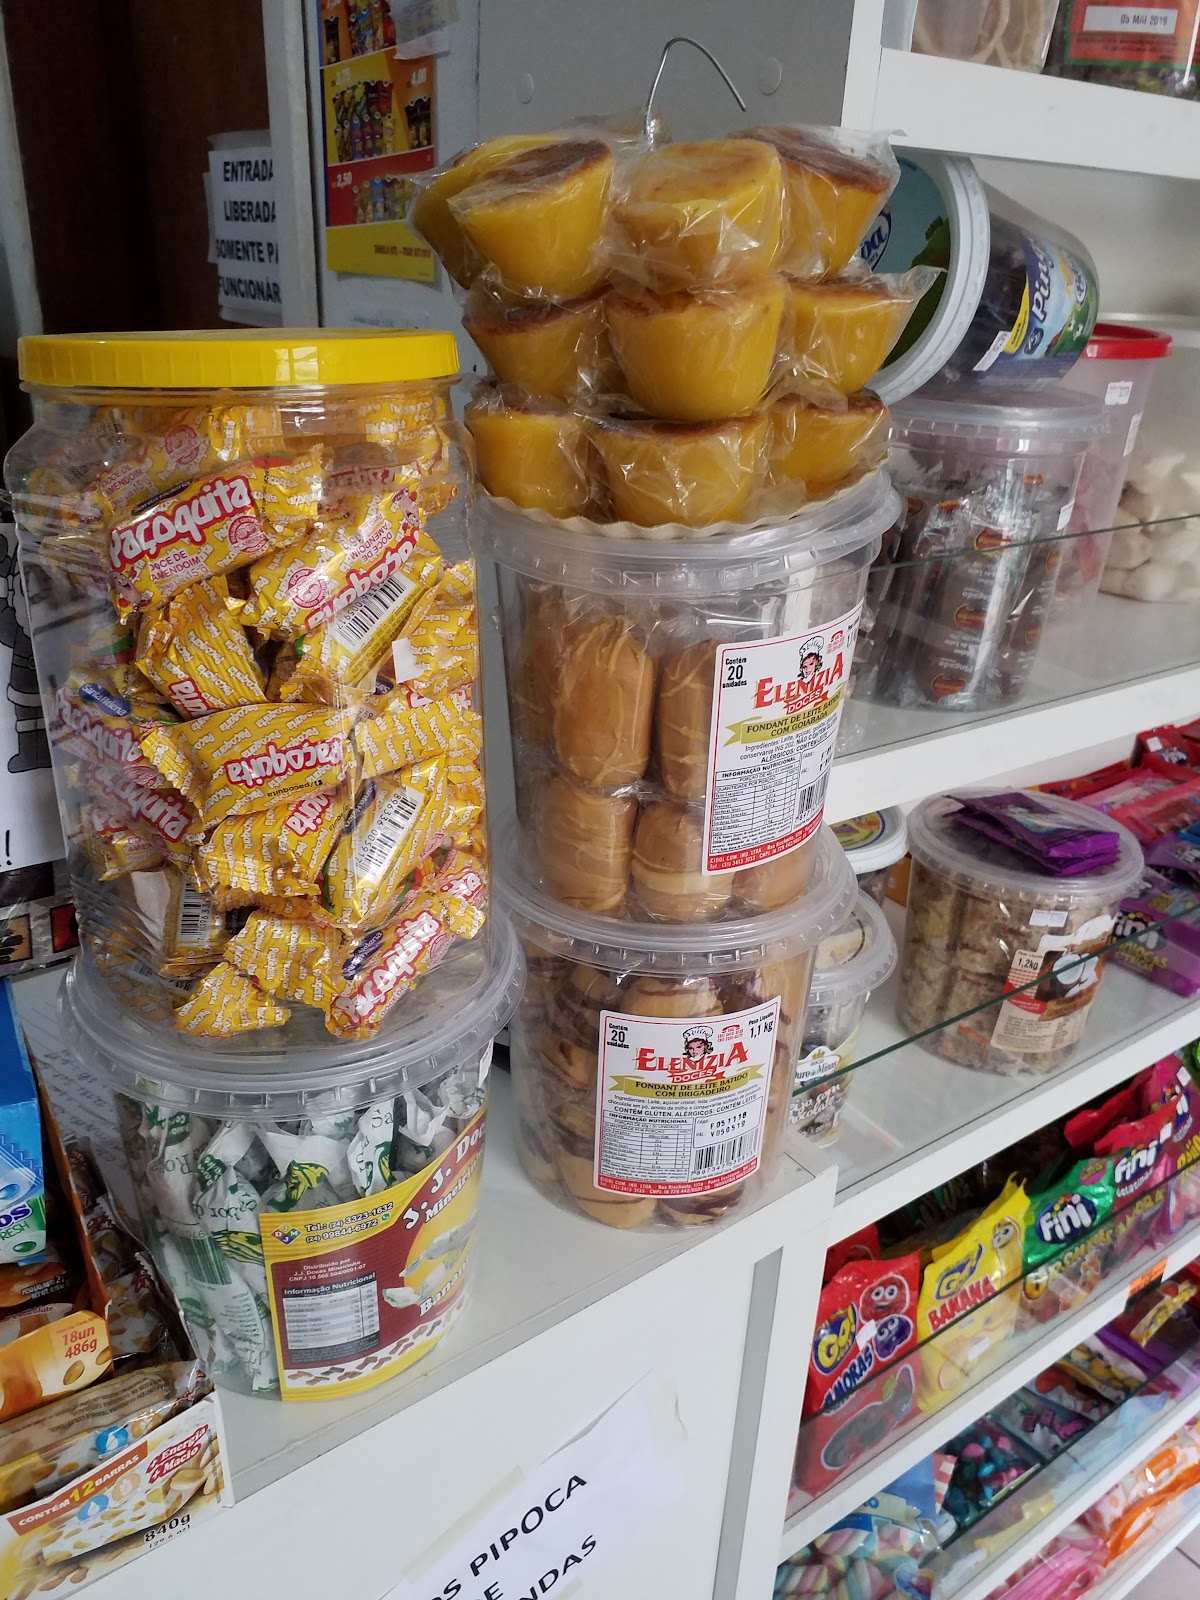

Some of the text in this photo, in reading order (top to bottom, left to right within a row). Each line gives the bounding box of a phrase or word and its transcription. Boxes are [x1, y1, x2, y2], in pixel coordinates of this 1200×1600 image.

[1150, 15, 1168, 26] 2019
[110, 478, 251, 568] Paçoquita
[174, 551, 188, 562] DE
[152, 556, 201, 581] AMENDOIM
[725, 657, 747, 666] Contém
[728, 665, 744, 681] 20
[722, 680, 747, 689] unidades
[787, 690, 821, 715] DOCES
[746, 718, 789, 734] FONDANT
[790, 714, 802, 724] DE
[802, 708, 821, 721] LEITE
[771, 711, 829, 737] COM GOIABADA
[227, 740, 343, 787] Paçoquita
[722, 766, 761, 779] INFORMAÇÃO
[762, 757, 797, 771] NUTRICIONAL
[608, 1022, 629, 1032] Contém
[748, 1018, 759, 1026] Peso
[764, 1020, 774, 1033] kg
[606, 1041, 630, 1049] unidades
[610, 1030, 626, 1043] 20
[673, 1068, 714, 1084] DOCES
[816, 1060, 838, 1075] Minas
[635, 1081, 678, 1091] FONDANT
[694, 1082, 718, 1090] LEITE
[719, 1072, 748, 1086] BATIDO
[678, 1085, 731, 1098] BRIGADEIRO
[614, 1106, 643, 1115] CONTÉM
[716, 1101, 741, 1113] CONTÉM
[742, 1094, 758, 1104] LEITE
[608, 1112, 647, 1122] INFORMAÇÃO
[1114, 1140, 1159, 1184] Fini
[304, 1202, 394, 1232] Tel.: (24) 3323-1632
[1039, 1194, 1093, 1243] Fini
[322, 1219, 379, 1241] 99844-6972
[284, 1272, 377, 1296] Informação Nutricional
[927, 1275, 996, 1333] BANANA
[62, 1326, 95, 1346] 18un
[64, 1339, 98, 1359] 486g
[161, 1428, 207, 1460] Energia
[164, 1447, 200, 1477] Macio
[18, 1454, 140, 1527] CONTÉM 12 BARRAS
[144, 1513, 192, 1543] 840g
[469, 1475, 588, 1578] PIPOCA
